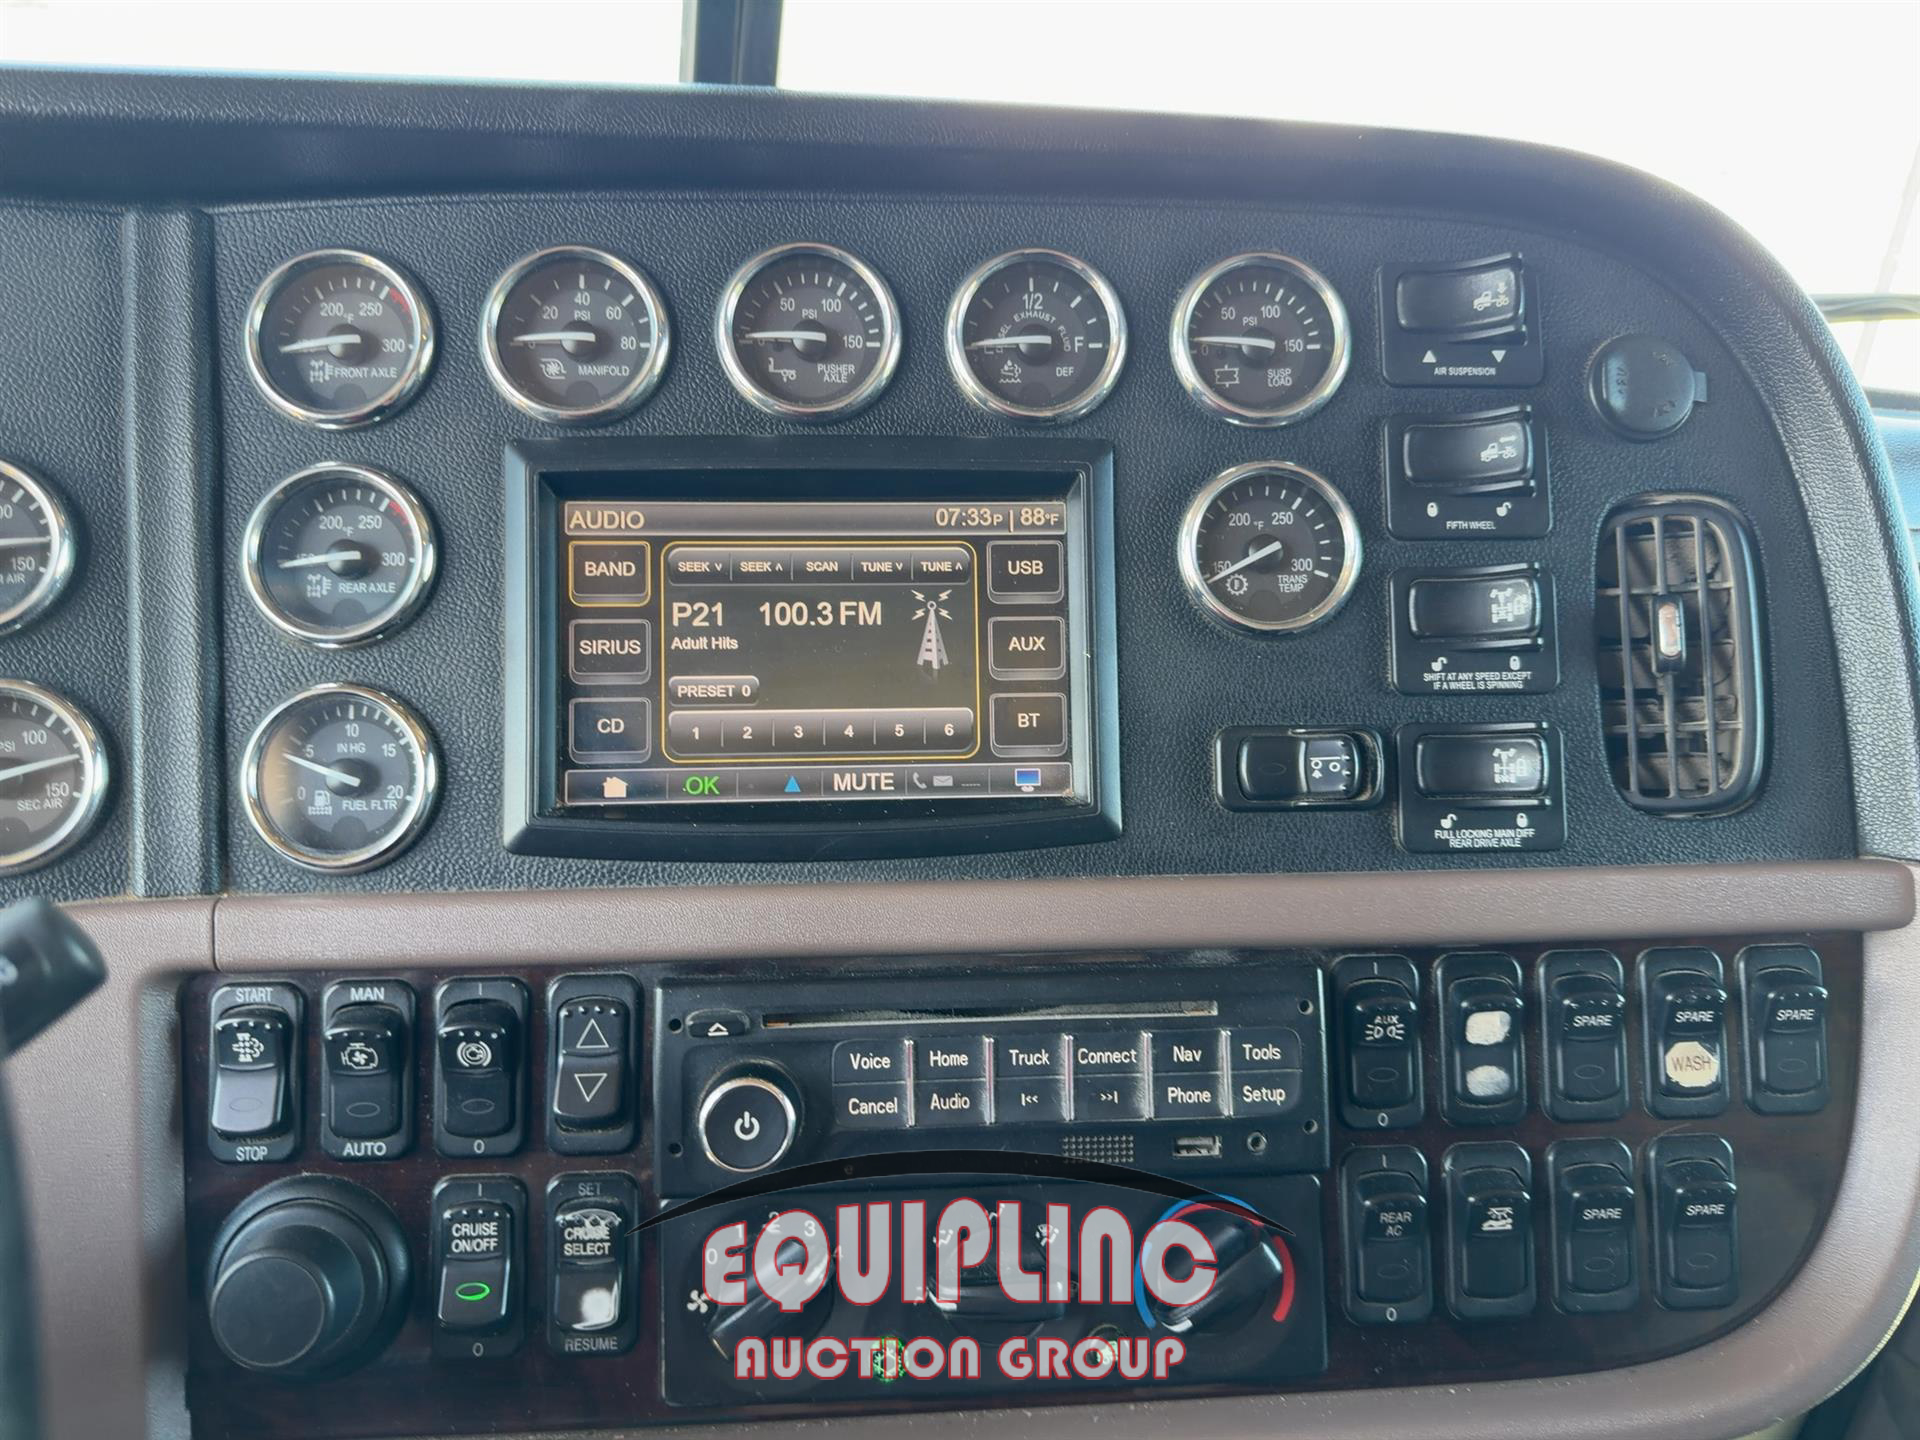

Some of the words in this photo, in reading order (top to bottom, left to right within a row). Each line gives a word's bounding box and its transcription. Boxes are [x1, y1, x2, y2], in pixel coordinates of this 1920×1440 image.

[574, 291, 590, 305] 40
[780, 298, 796, 311] 50
[821, 298, 841, 312] 100
[1022, 293, 1043, 310] 1/2
[320, 302, 344, 316] 200
[359, 302, 383, 316] 250
[542, 305, 559, 319] 20
[574, 310, 591, 321] PSI
[606, 305, 622, 320] 60
[802, 308, 818, 319] PSI
[1013, 310, 1056, 322] EXHAUST
[1221, 306, 1236, 320] 50
[1260, 305, 1280, 318] 100
[1242, 316, 1258, 327] PSI
[382, 338, 405, 352] 300
[620, 336, 636, 350] 80
[843, 335, 863, 349] 150
[1074, 336, 1084, 352] F
[1284, 339, 1303, 352] 150
[336, 367, 368, 378] FRONT
[370, 367, 397, 378] AXLE
[578, 364, 630, 376] MANIFOLD
[817, 363, 855, 374] PUSHER
[1056, 366, 1074, 377] DEF
[1267, 368, 1291, 378] SUSP
[1433, 367, 1447, 376] AIR
[1448, 366, 1496, 376] SUSPENSION
[823, 373, 848, 383] AXLE
[1267, 377, 1292, 387] LOAD
[319, 515, 343, 529] 200
[358, 515, 382, 529] 250
[569, 510, 645, 529] AUDIO
[1228, 512, 1251, 526] 200
[1271, 511, 1293, 525] 250
[1446, 520, 1468, 530] FIFTH
[1469, 520, 1496, 530] WHEEL
[11, 556, 36, 571] 150
[381, 552, 405, 566] 300
[1291, 558, 1312, 571] 300
[584, 561, 636, 577] BAND
[678, 561, 710, 573] SEEK
[740, 561, 771, 572] SEEK
[806, 561, 839, 573] SCAN
[861, 561, 893, 573] TUNE
[920, 561, 952, 572] TUNE
[1007, 560, 1044, 576] USB
[6, 572, 26, 584] AIR
[1277, 574, 1308, 584] TRANS
[338, 582, 368, 593] REAR
[369, 582, 396, 593] AXLE
[1279, 583, 1304, 593] TEMP
[672, 601, 723, 627] P21
[759, 601, 834, 628] 100.3
[840, 601, 882, 626] FM
[579, 639, 642, 655] SIRIUS
[671, 636, 709, 651] Adult
[711, 636, 739, 651] Hits
[1008, 636, 1046, 651] AUX
[1423, 672, 1446, 682] SHIFT
[1447, 672, 1456, 681] AT
[1457, 672, 1473, 681] ANY
[1475, 671, 1500, 680] SPEED
[1502, 671, 1532, 680] EXCEPT
[677, 684, 735, 698] PRESET
[742, 684, 751, 698] 0
[1433, 681, 1441, 690] IF
[1442, 681, 1449, 690] A
[1449, 681, 1475, 690] WHEEL
[1477, 681, 1485, 690] IS
[1486, 680, 1524, 690] SPINNING
[596, 718, 625, 734] CD
[1017, 711, 1041, 729] BT
[22, 729, 48, 745] 100
[344, 723, 360, 737] 10
[691, 726, 700, 740] 1
[742, 726, 753, 739] 2
[793, 725, 804, 739] 3
[844, 724, 855, 738] 4
[894, 723, 905, 737] 5
[943, 722, 955, 737] 6
[304, 744, 314, 758] 5
[336, 743, 348, 753] IN
[350, 743, 366, 753] HG
[381, 743, 396, 757] 15
[45, 781, 70, 797] 150
[684, 775, 720, 795] OK
[833, 772, 895, 792] MUTE
[387, 784, 404, 799] 20
[17, 799, 40, 811] SEC
[43, 798, 63, 809] AIR
[342, 799, 368, 811] FUEL
[370, 799, 398, 811] FLTR
[1434, 829, 1455, 839] FULL
[1456, 828, 1493, 839] LOCKING
[1494, 828, 1515, 838] MAIN
[1515, 828, 1535, 838] DIFF
[1449, 838, 1472, 848] REAR
[1473, 838, 1499, 848] DRIVE
[1500, 837, 1522, 848] AXLE
[235, 987, 273, 1003] START
[350, 987, 385, 1002] MAN
[1374, 1014, 1400, 1025] AUX
[1573, 1014, 1613, 1027] SPARE
[1675, 1011, 1714, 1023] SPARE
[1776, 1008, 1815, 1021] SPARE
[929, 1050, 969, 1067] Home
[1009, 1049, 1050, 1067] Truck
[1077, 1048, 1137, 1065] Connect
[1173, 1045, 1202, 1063] Nav
[1242, 1043, 1282, 1061] Tools
[850, 1053, 891, 1070] Voice
[1671, 1055, 1712, 1073] WASH
[930, 1093, 971, 1111] Audio
[1167, 1086, 1212, 1104] Phone
[1242, 1085, 1286, 1106] Setup
[849, 1096, 898, 1115] Cancel
[235, 1146, 269, 1161] STOP
[342, 1141, 387, 1158] AUTO
[578, 1182, 601, 1196] SET
[1582, 1207, 1623, 1221] SPARE
[1686, 1203, 1726, 1217] SPARE
[1380, 1211, 1412, 1224] REAR
[451, 1221, 499, 1237] CRUISE
[1385, 1224, 1403, 1237] AC
[451, 1238, 499, 1253] ON/OFF
[563, 1242, 611, 1257] SELECT
[564, 1336, 619, 1352] RESUME
